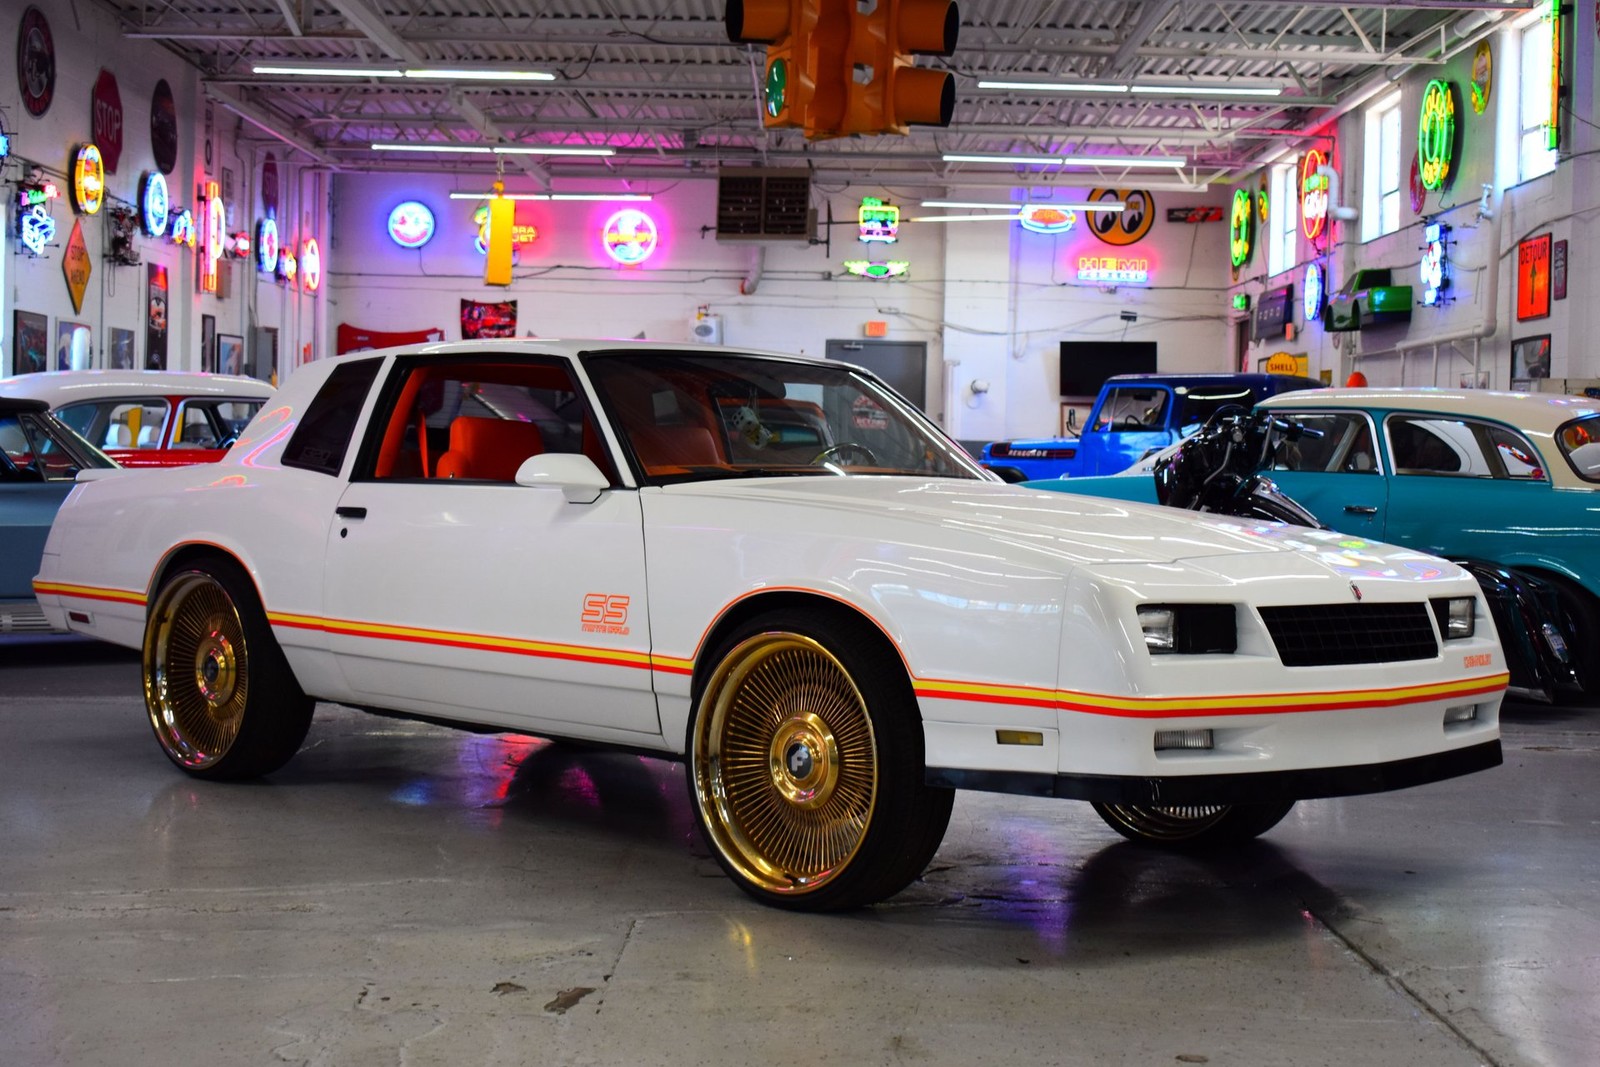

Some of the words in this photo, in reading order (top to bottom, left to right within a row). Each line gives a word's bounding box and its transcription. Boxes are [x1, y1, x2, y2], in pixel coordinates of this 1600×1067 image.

[96, 100, 120, 144] STOP
[512, 226, 536, 234] BRA
[70, 244, 85, 261] STOP
[1520, 241, 1547, 266] DETOUR
[1079, 257, 1148, 272] HEMI
[1258, 306, 1281, 320] FORD
[1269, 363, 1294, 372] SHELL
[1008, 448, 1048, 457] RENEGADE
[581, 593, 630, 625] SS
